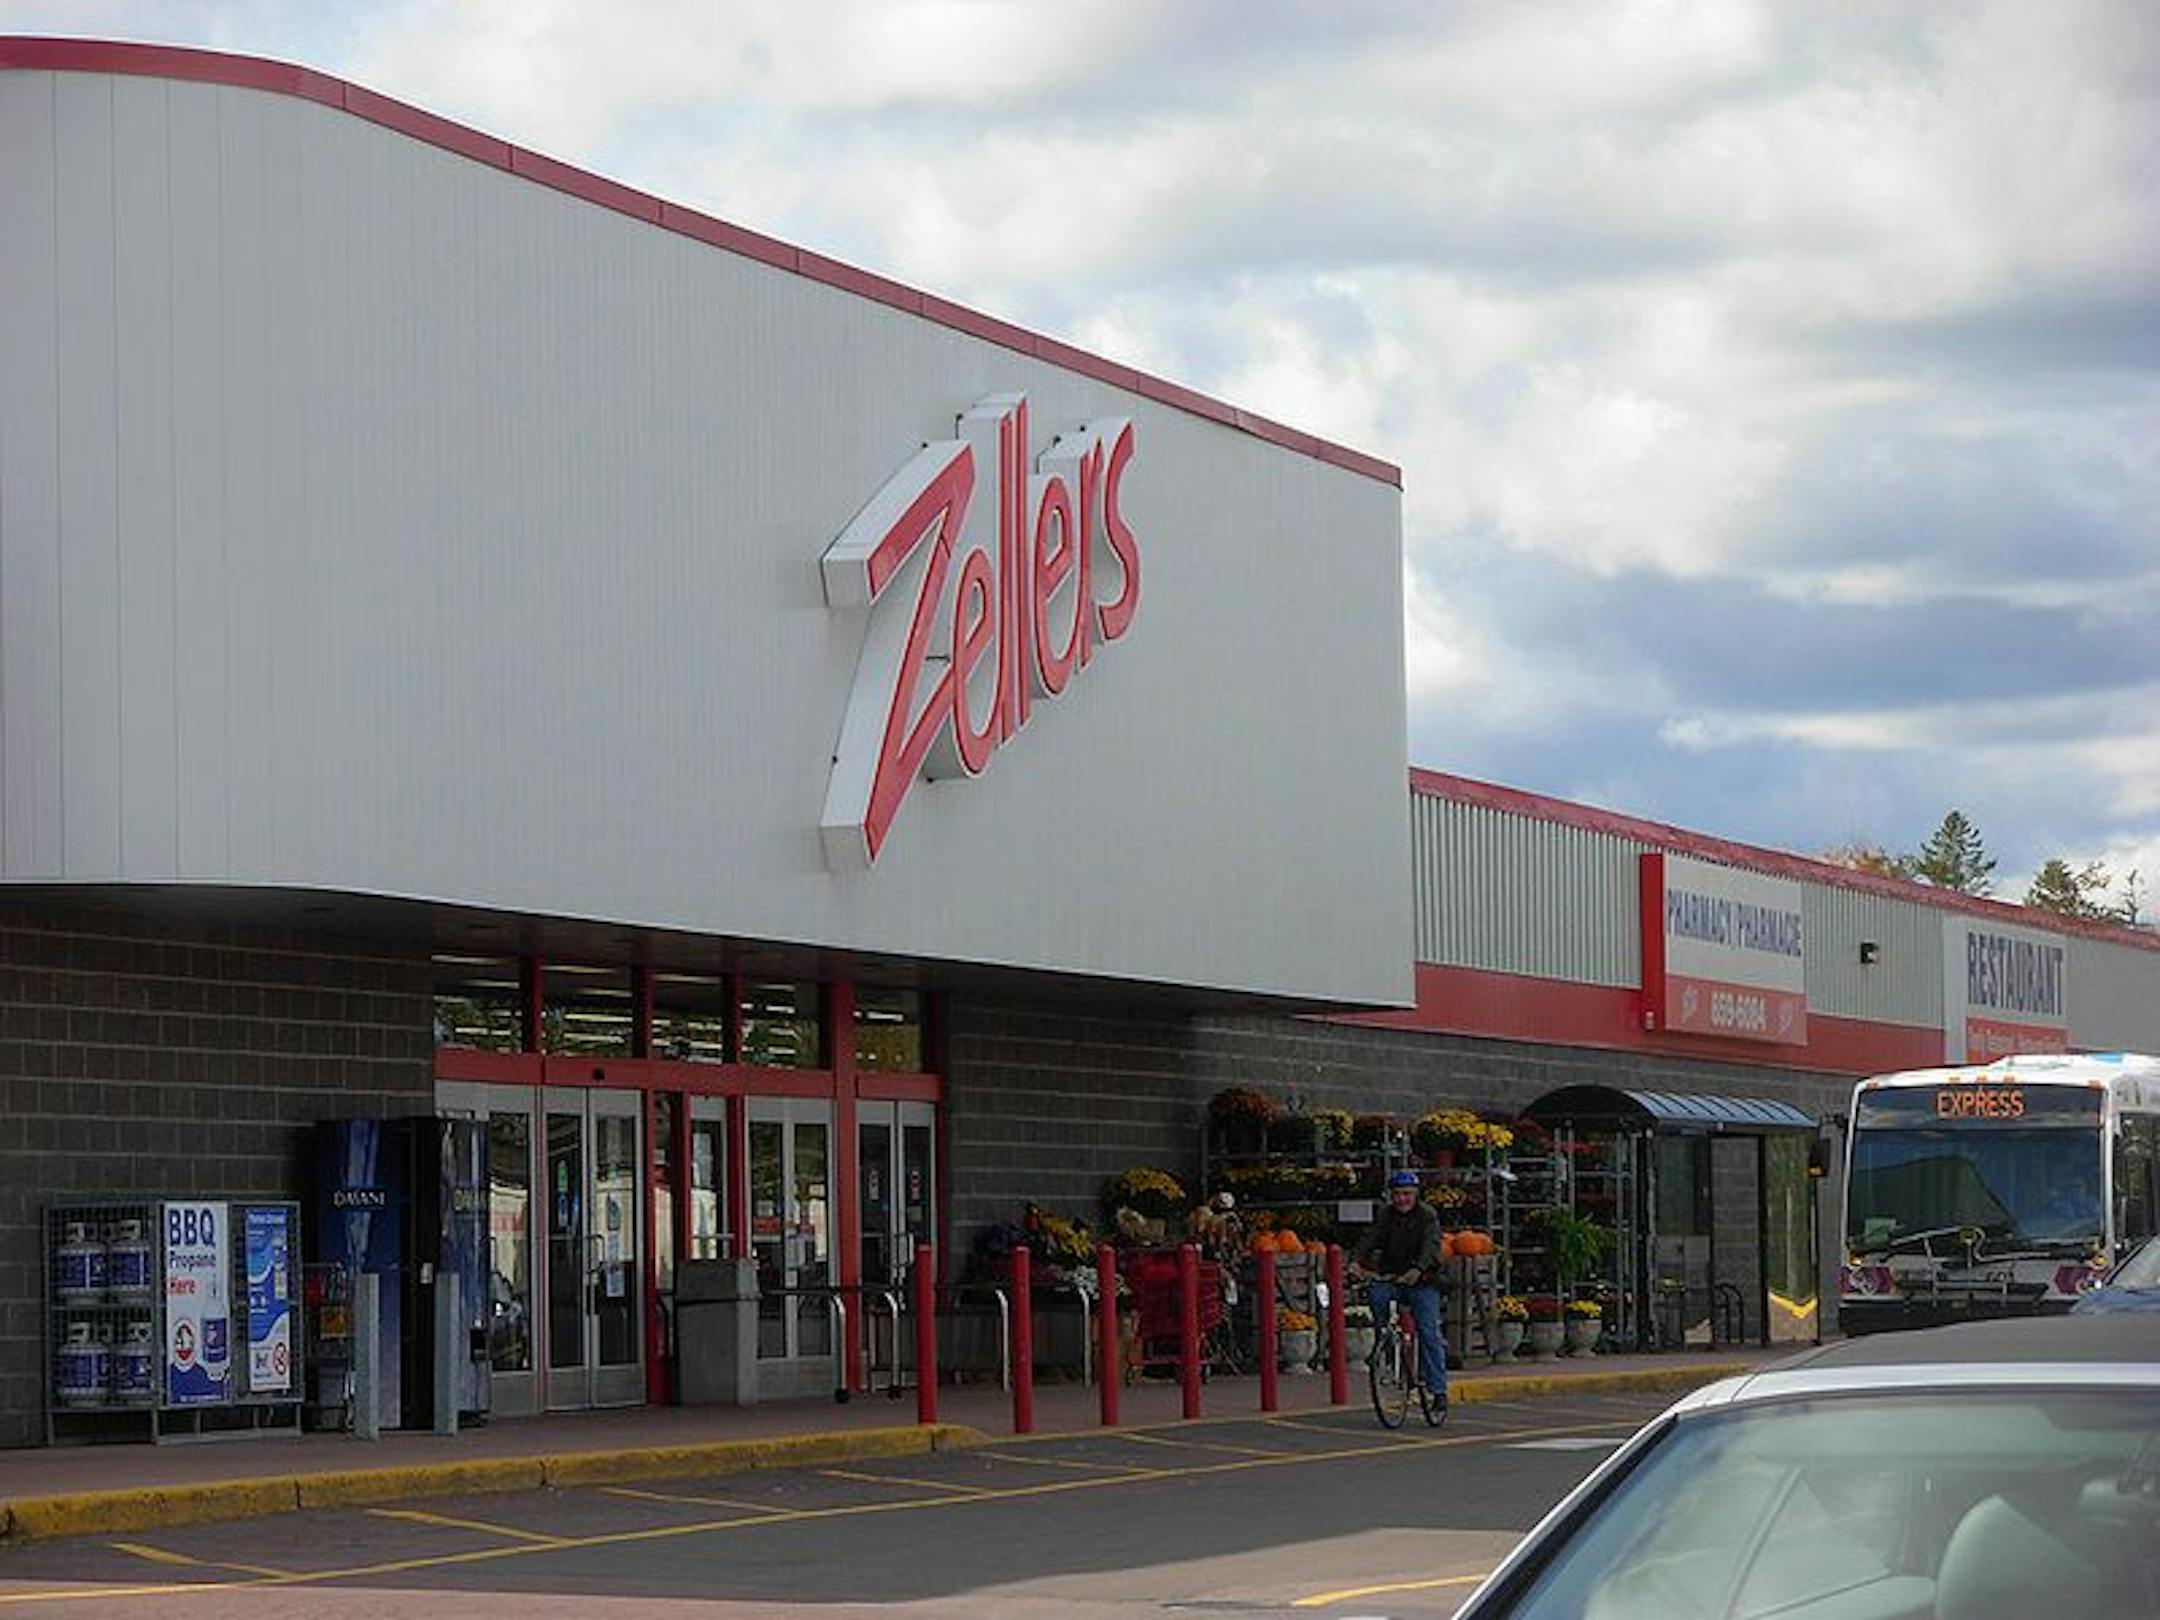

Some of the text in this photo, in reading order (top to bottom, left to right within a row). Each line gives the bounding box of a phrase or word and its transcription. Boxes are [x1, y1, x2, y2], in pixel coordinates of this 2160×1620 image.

[861, 389, 1141, 867] Zellers
[1967, 931, 2064, 1016] RESTAURANT
[1935, 1089, 2025, 1119] EXPRESS
[169, 1208, 216, 1248] BBQ
[169, 1251, 217, 1272] Propane
